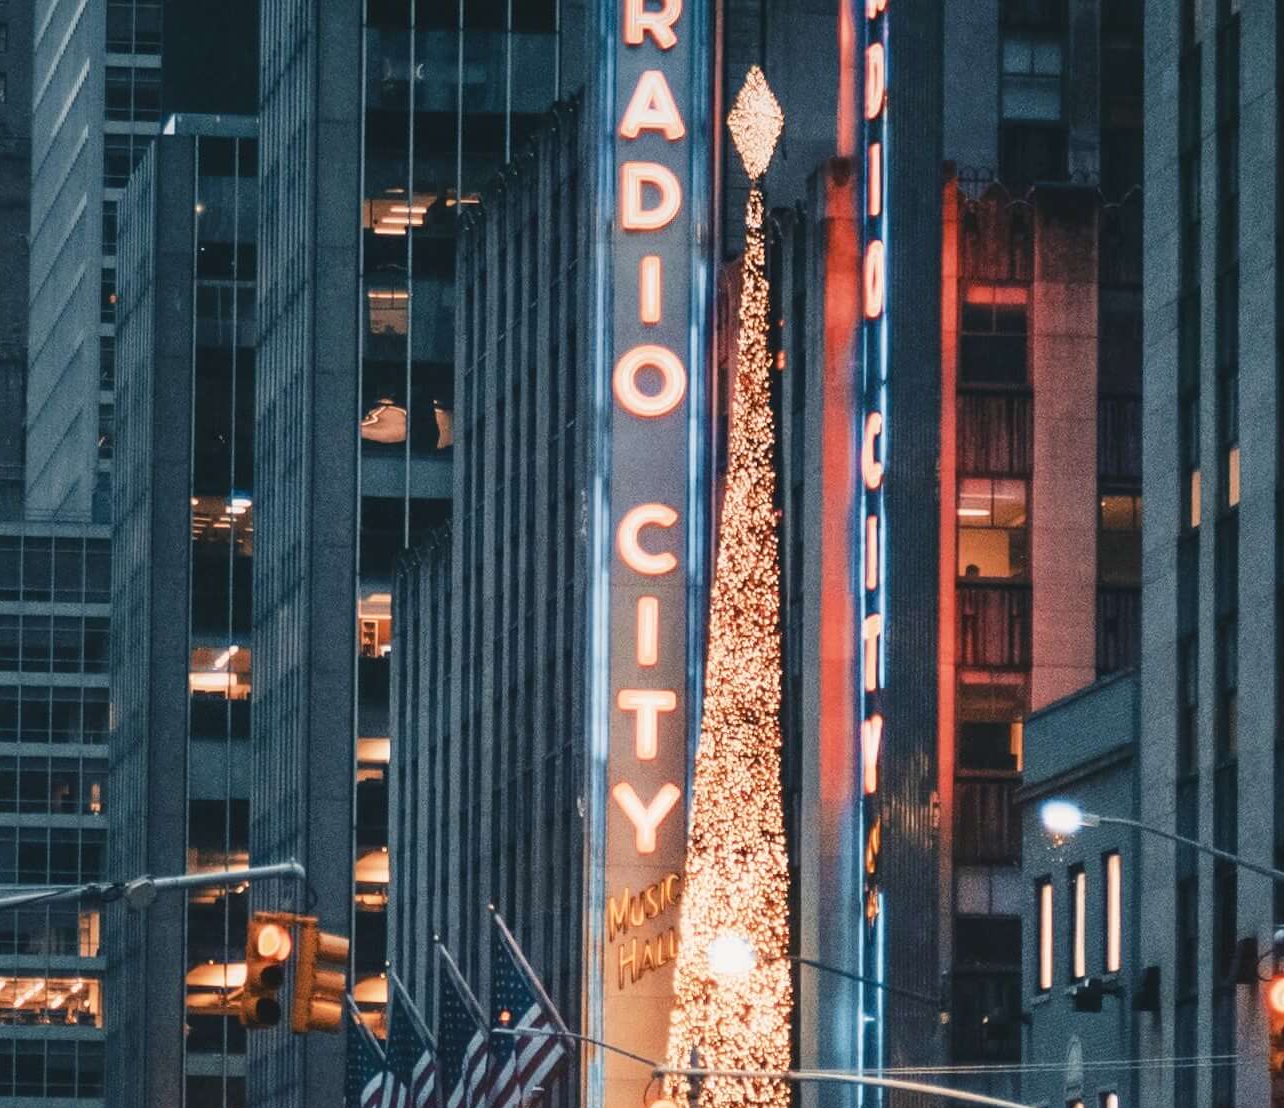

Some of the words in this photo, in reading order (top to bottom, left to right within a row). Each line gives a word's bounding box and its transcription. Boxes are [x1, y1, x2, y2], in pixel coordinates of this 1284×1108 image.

[613, 0, 686, 416] RADIO
[613, 503, 680, 854] CITY
[609, 873, 681, 943] MUSIC
[618, 926, 679, 991] HALL
